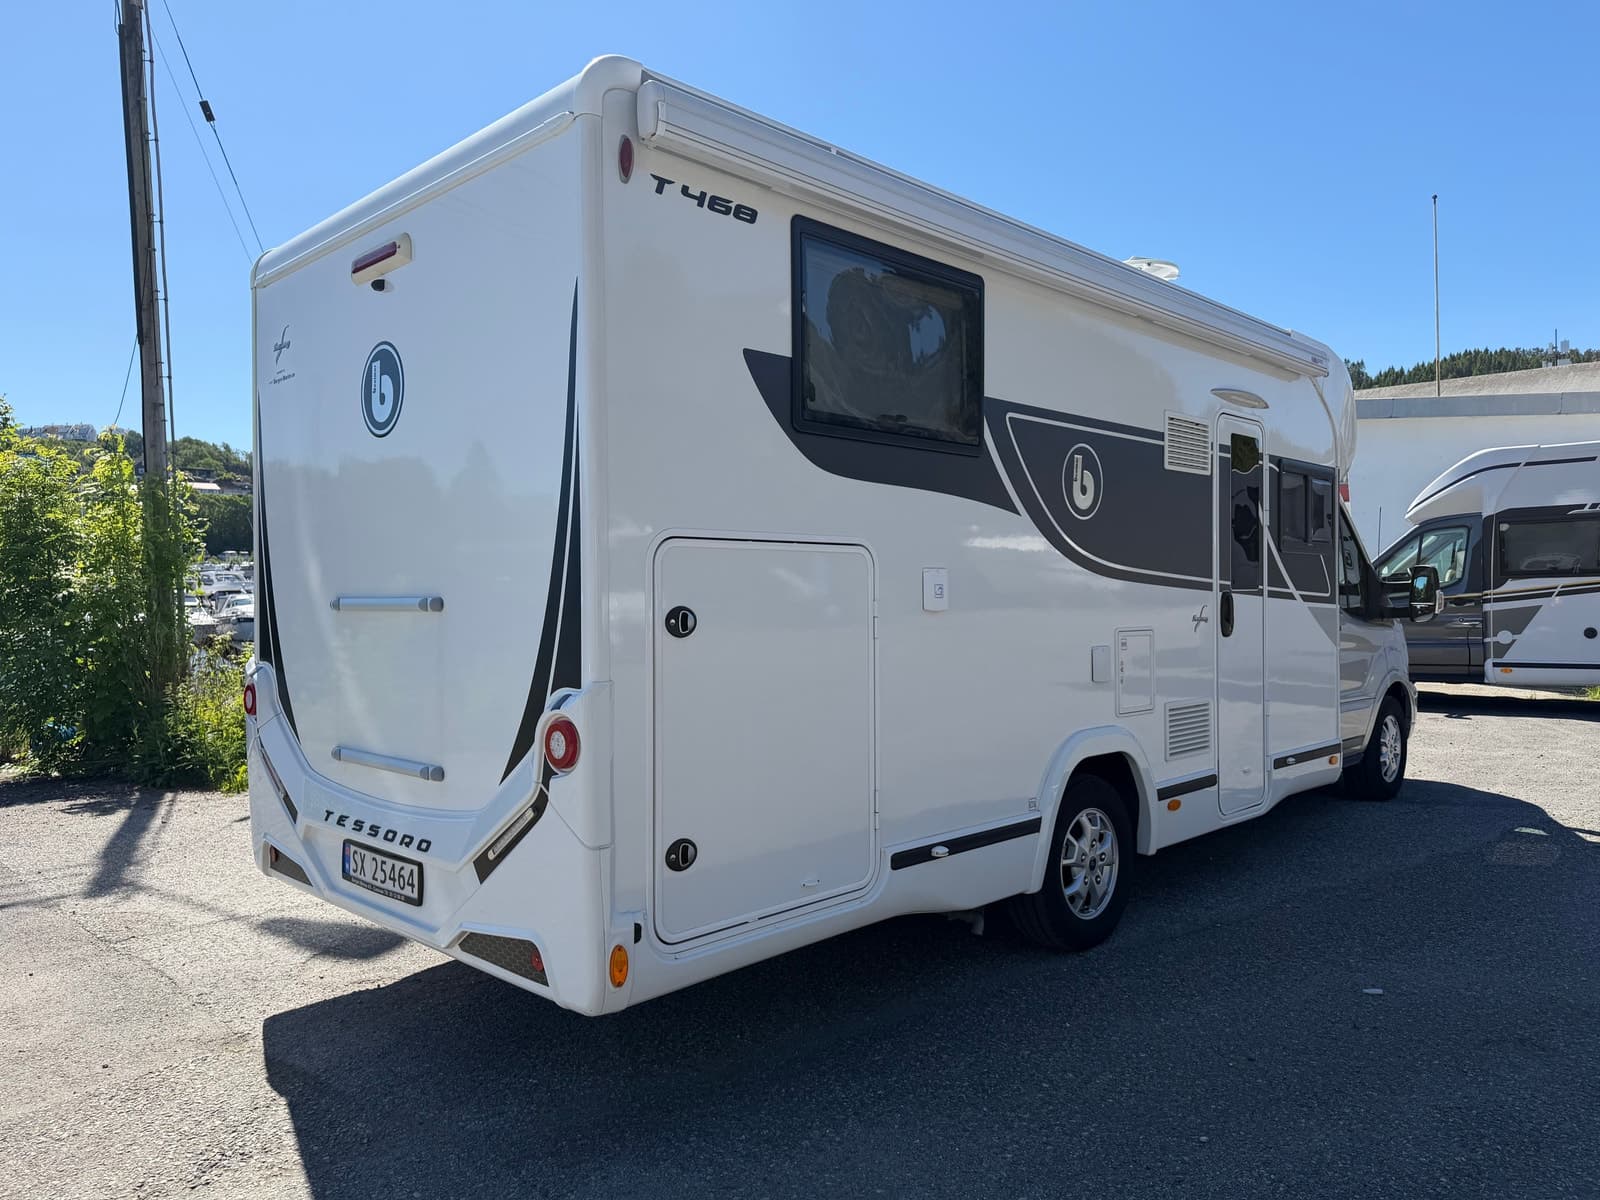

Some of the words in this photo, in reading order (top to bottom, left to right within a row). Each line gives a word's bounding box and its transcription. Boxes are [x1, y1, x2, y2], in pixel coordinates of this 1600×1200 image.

[650, 173, 675, 195] T
[681, 184, 758, 224] 468
[323, 809, 432, 853] TESSORO
[352, 850, 366, 877] SX
[372, 857, 416, 894] 25464
